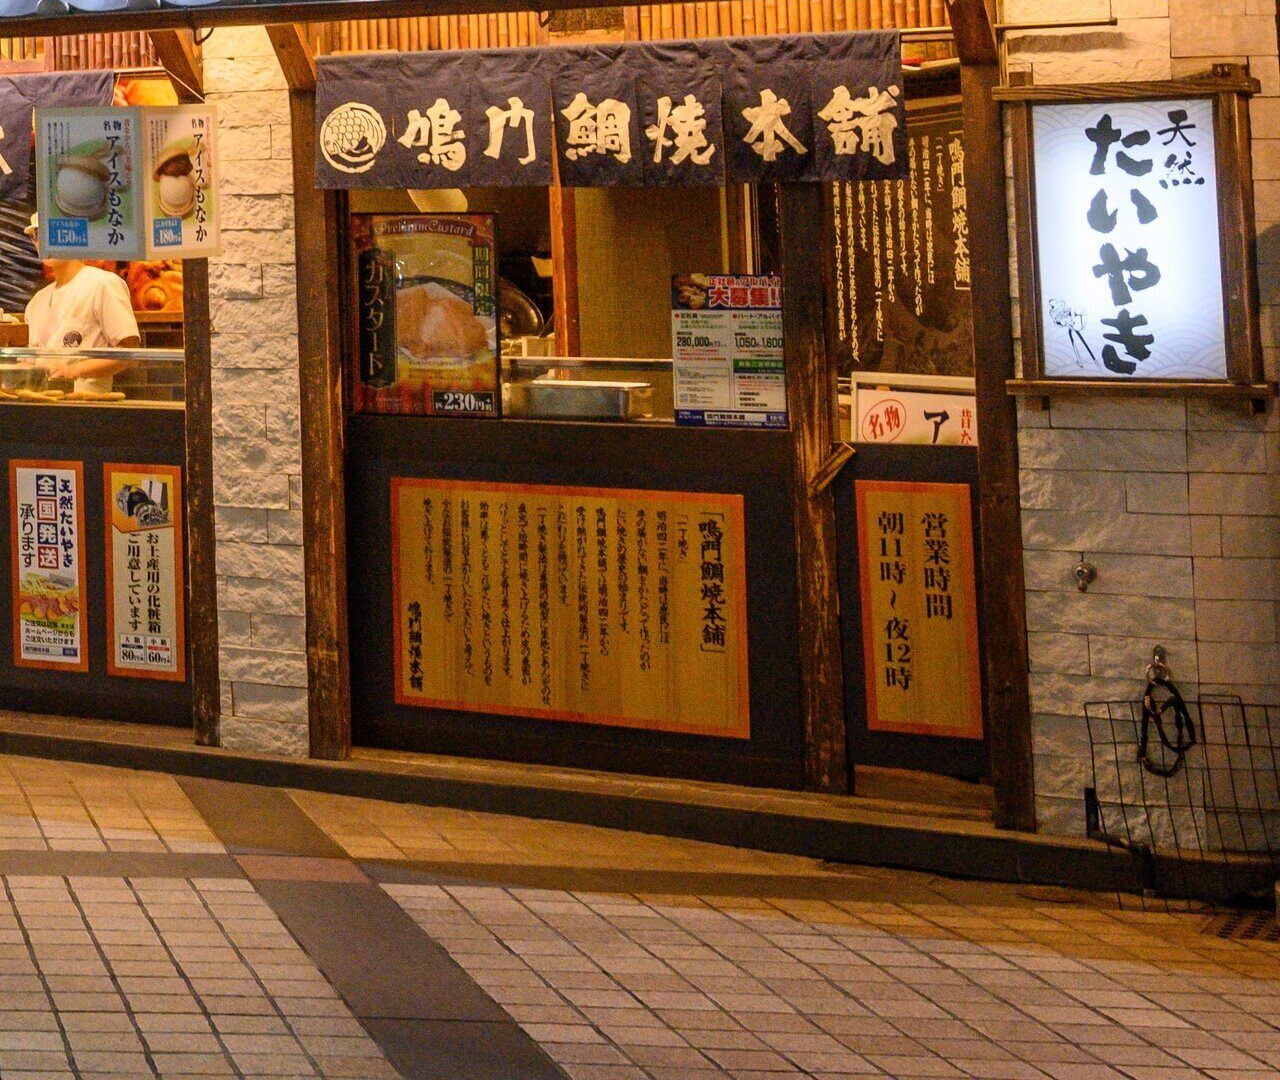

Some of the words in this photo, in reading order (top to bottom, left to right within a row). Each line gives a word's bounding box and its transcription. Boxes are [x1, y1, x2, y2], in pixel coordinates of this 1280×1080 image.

[103, 120, 122, 131] 名物
[397, 85, 900, 172] 鳴門鯛焼本舗
[1156, 109, 1205, 189] 天然
[106, 135, 125, 246] アイスもなか
[193, 133, 208, 243] アイスもなか
[948, 130, 971, 291] 「鳴門鯛焼本舗」
[1084, 113, 1161, 375] たいやき
[365, 260, 384, 376] カスタード
[868, 405, 901, 440] 名物
[923, 409, 950, 443] ア
[19, 503, 36, 567] 承ります
[37, 475, 58, 568] 全国発送
[58, 478, 74, 568] 天然たいやき
[920, 512, 954, 620] 営業時間
[127, 533, 141, 631] ご用意しています
[146, 533, 161, 633] お土産用の化粧箱
[698, 512, 726, 654] 「鳴門鯛焼本舗」
